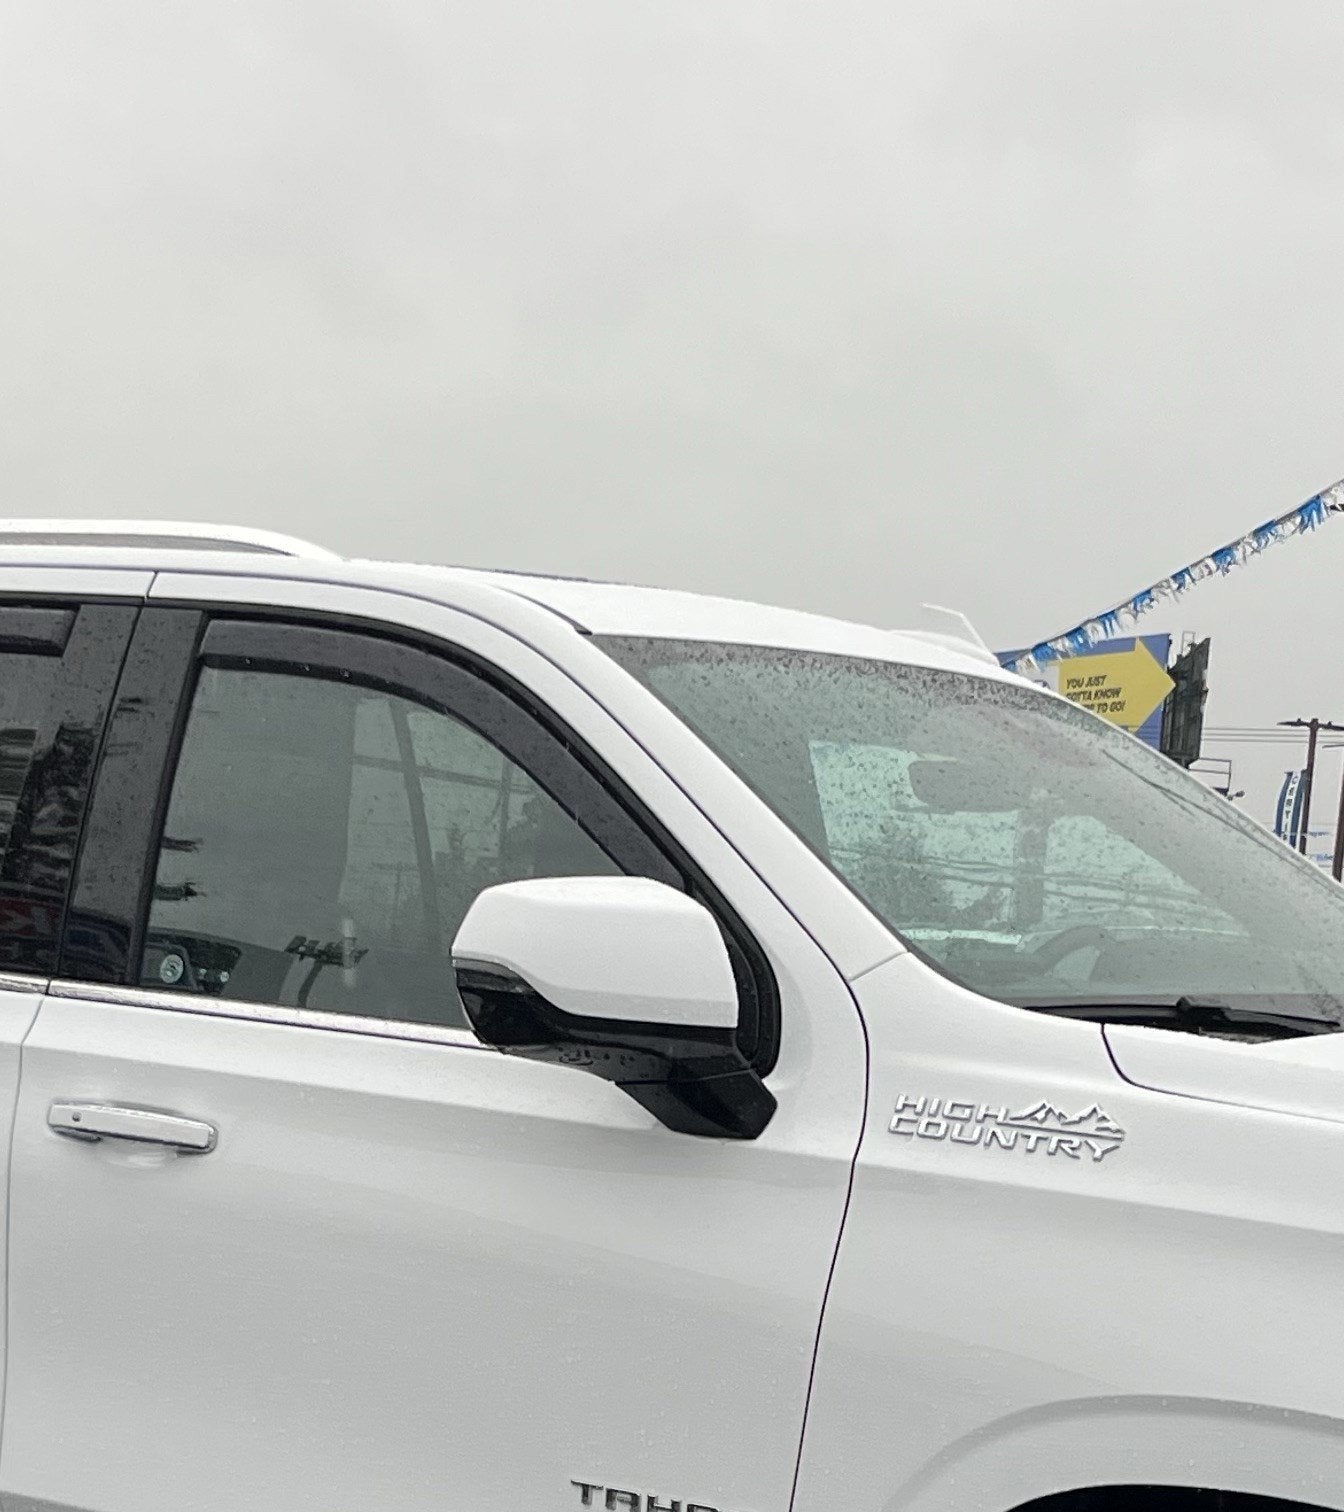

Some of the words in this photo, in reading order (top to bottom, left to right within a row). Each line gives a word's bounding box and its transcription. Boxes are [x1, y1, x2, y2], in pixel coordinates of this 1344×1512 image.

[1067, 677, 1084, 689] YOU
[1086, 675, 1107, 687] JUST
[1094, 687, 1123, 701] KNOW
[1097, 702, 1108, 713] TO
[894, 1093, 1008, 1124] HIGH
[887, 1113, 1121, 1162] COUNTRY
